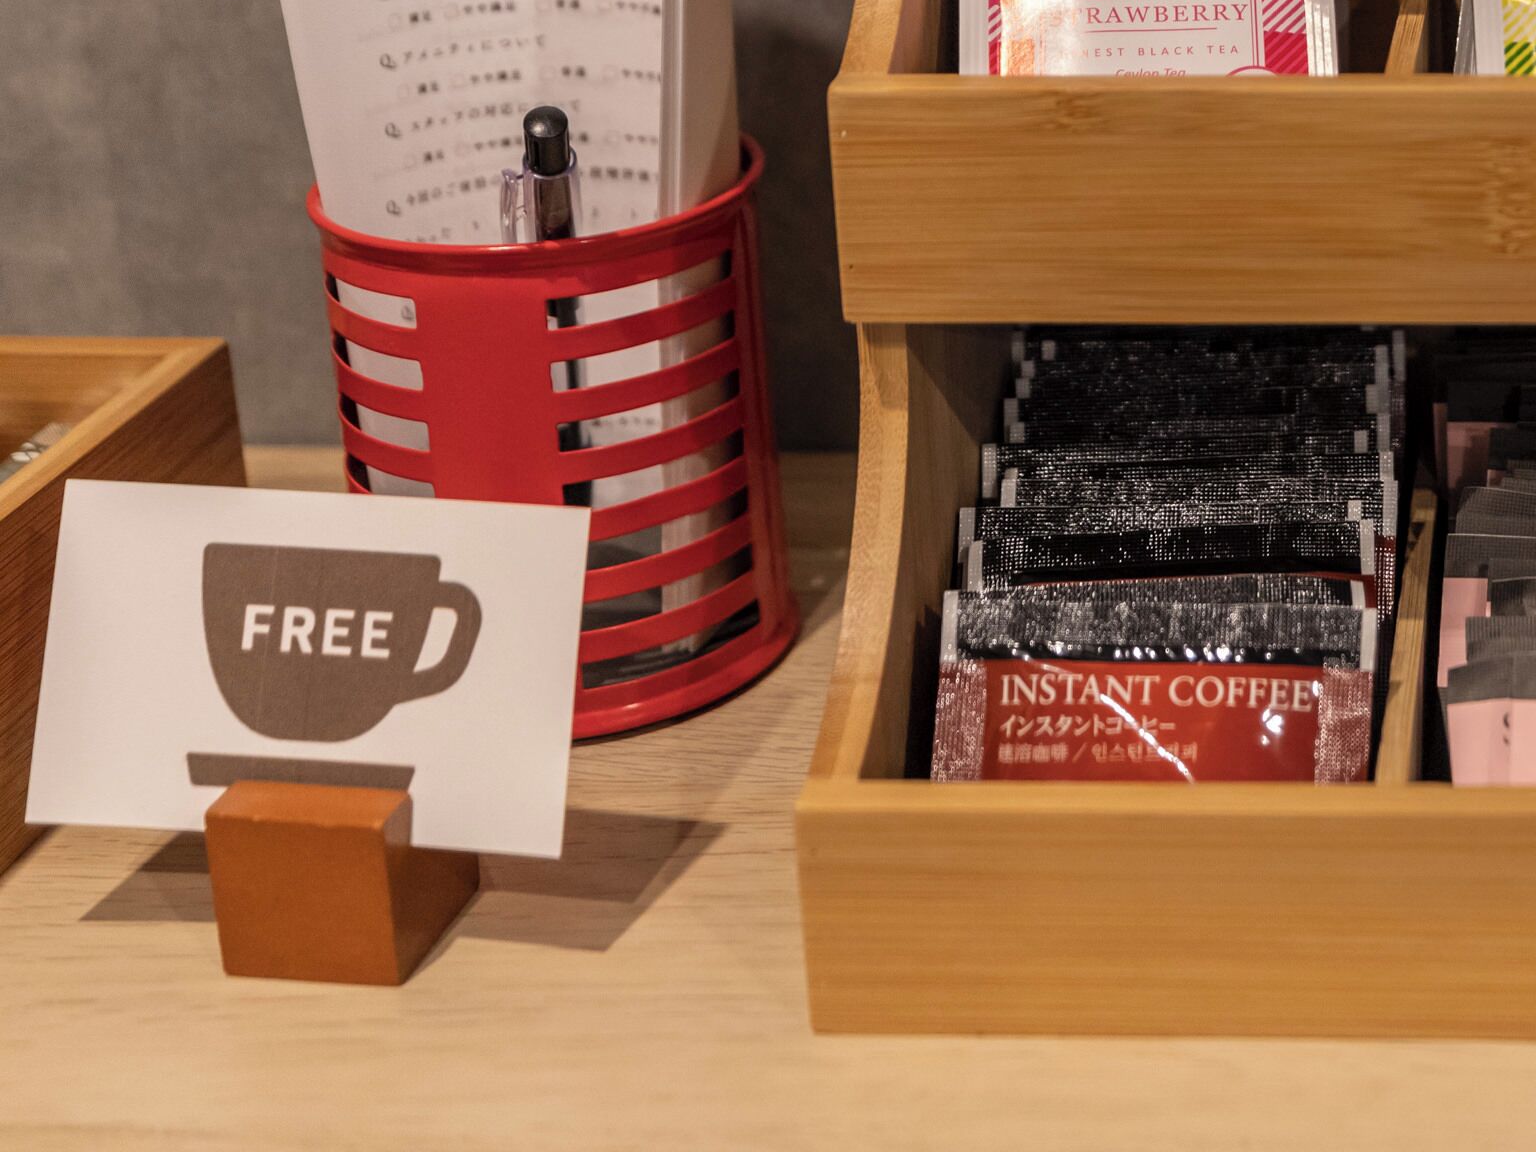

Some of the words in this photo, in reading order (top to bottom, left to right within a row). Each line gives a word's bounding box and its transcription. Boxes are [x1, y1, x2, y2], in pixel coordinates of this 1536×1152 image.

[1050, 3, 1249, 27] RAWBERRY
[1138, 46, 1194, 57] BLACK
[1207, 44, 1239, 55] TEA
[240, 603, 394, 659] FREE
[1000, 673, 1160, 707] INSTANT
[1168, 674, 1314, 713] COFFEE
